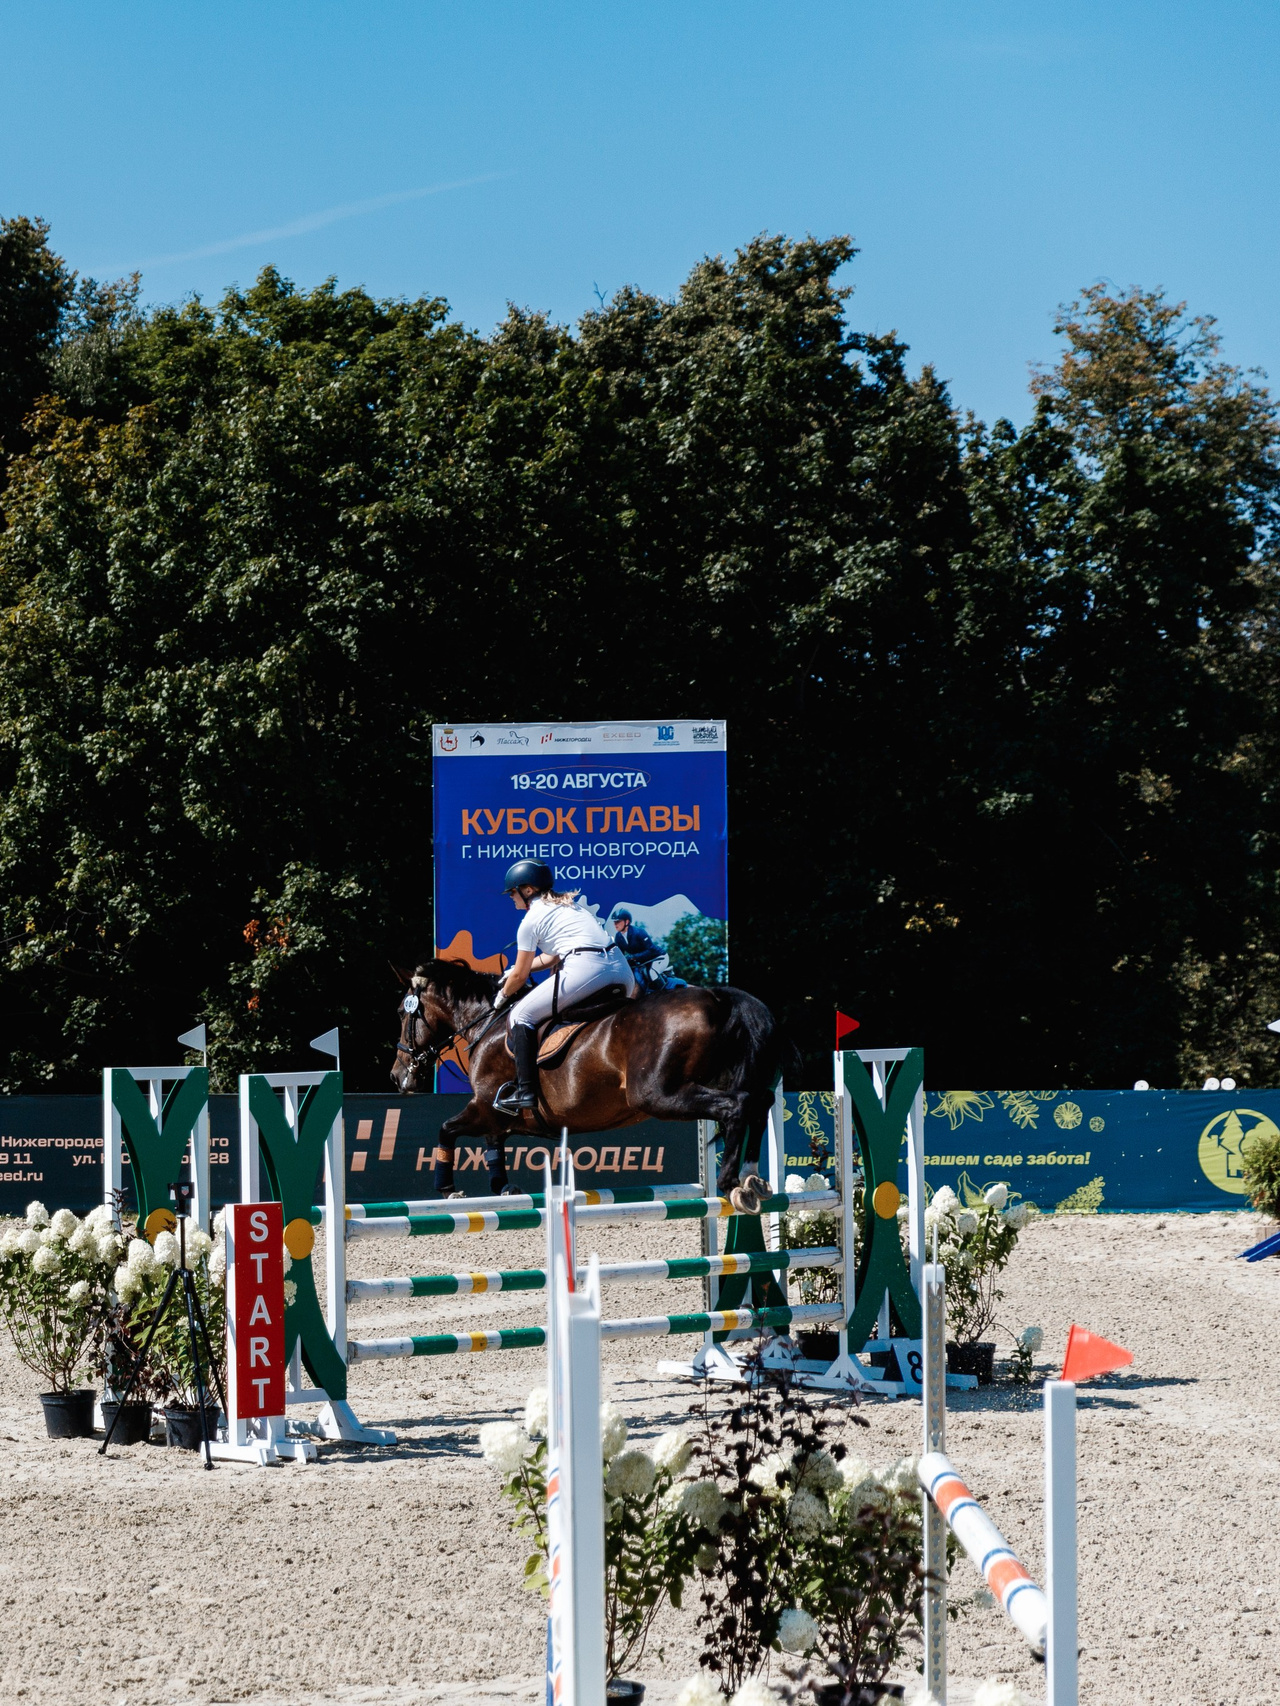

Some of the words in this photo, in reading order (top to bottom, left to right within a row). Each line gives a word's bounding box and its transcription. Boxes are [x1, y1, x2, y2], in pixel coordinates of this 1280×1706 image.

[510, 774, 558, 790] 19-20
[562, 772, 647, 789] АВГУСТА
[461, 807, 579, 836] КУБОК
[586, 804, 700, 834] ГЛАВЫ
[461, 845, 472, 859] Г.
[478, 842, 573, 859] НИЖНЕГО
[579, 840, 700, 858] НОВГОРОДА
[554, 864, 646, 880] КОНКУРУ
[1, 1136, 104, 1149] Нижегороде
[13, 1153, 33, 1165] 11
[72, 1154, 97, 1167] ул.
[983, 1155, 1024, 1167] саде
[1026, 1151, 1092, 1166] забота!
[249, 1210, 272, 1410] START
[907, 1350, 924, 1385] 8
